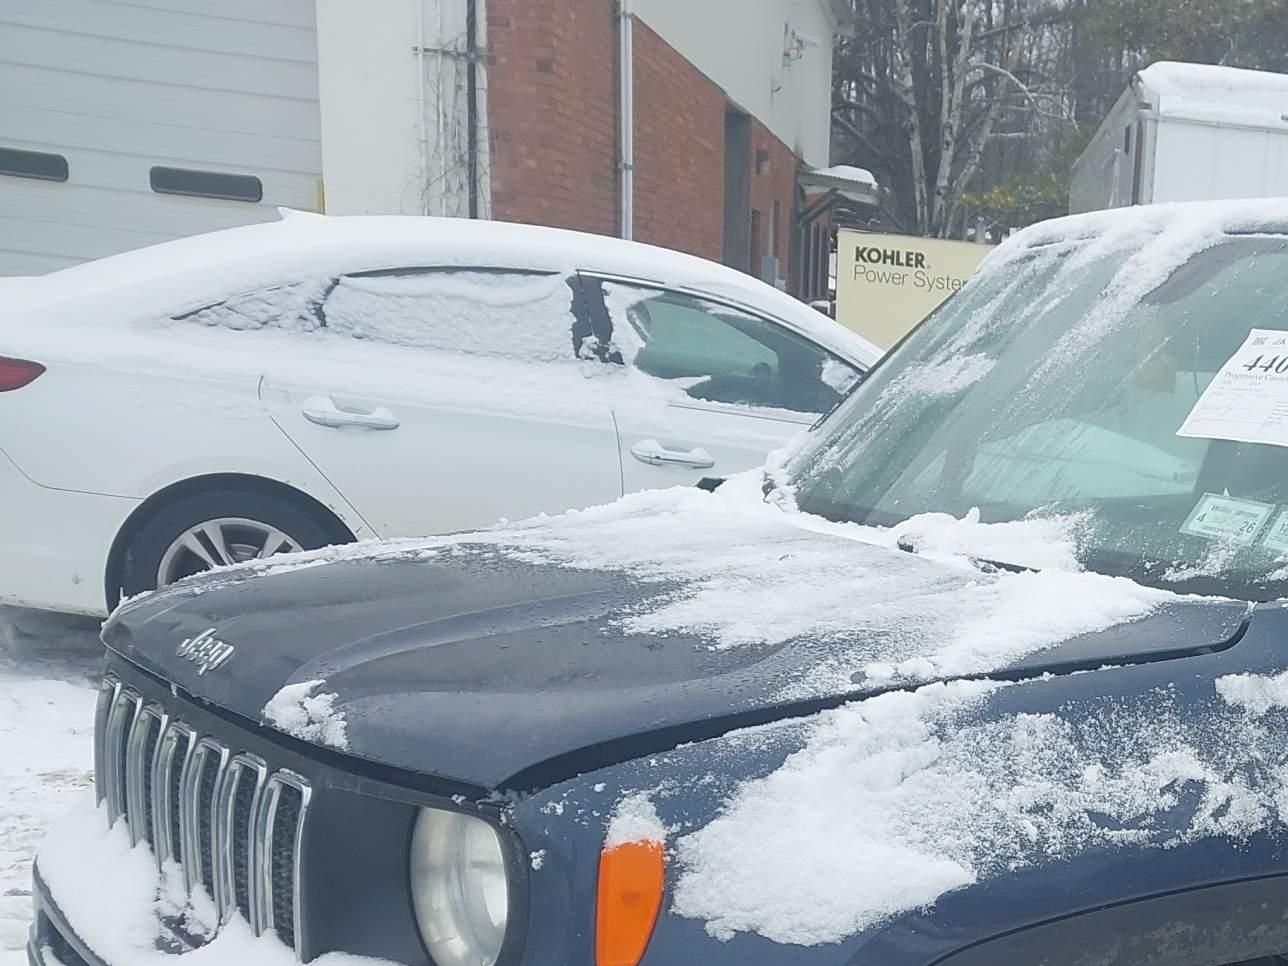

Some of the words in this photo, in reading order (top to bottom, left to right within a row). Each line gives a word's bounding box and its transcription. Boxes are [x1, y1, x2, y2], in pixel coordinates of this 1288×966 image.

[855, 246, 925, 269] KOHLER
[853, 264, 908, 286] Power
[1239, 520, 1256, 534] 26
[176, 628, 234, 676] Jeep
